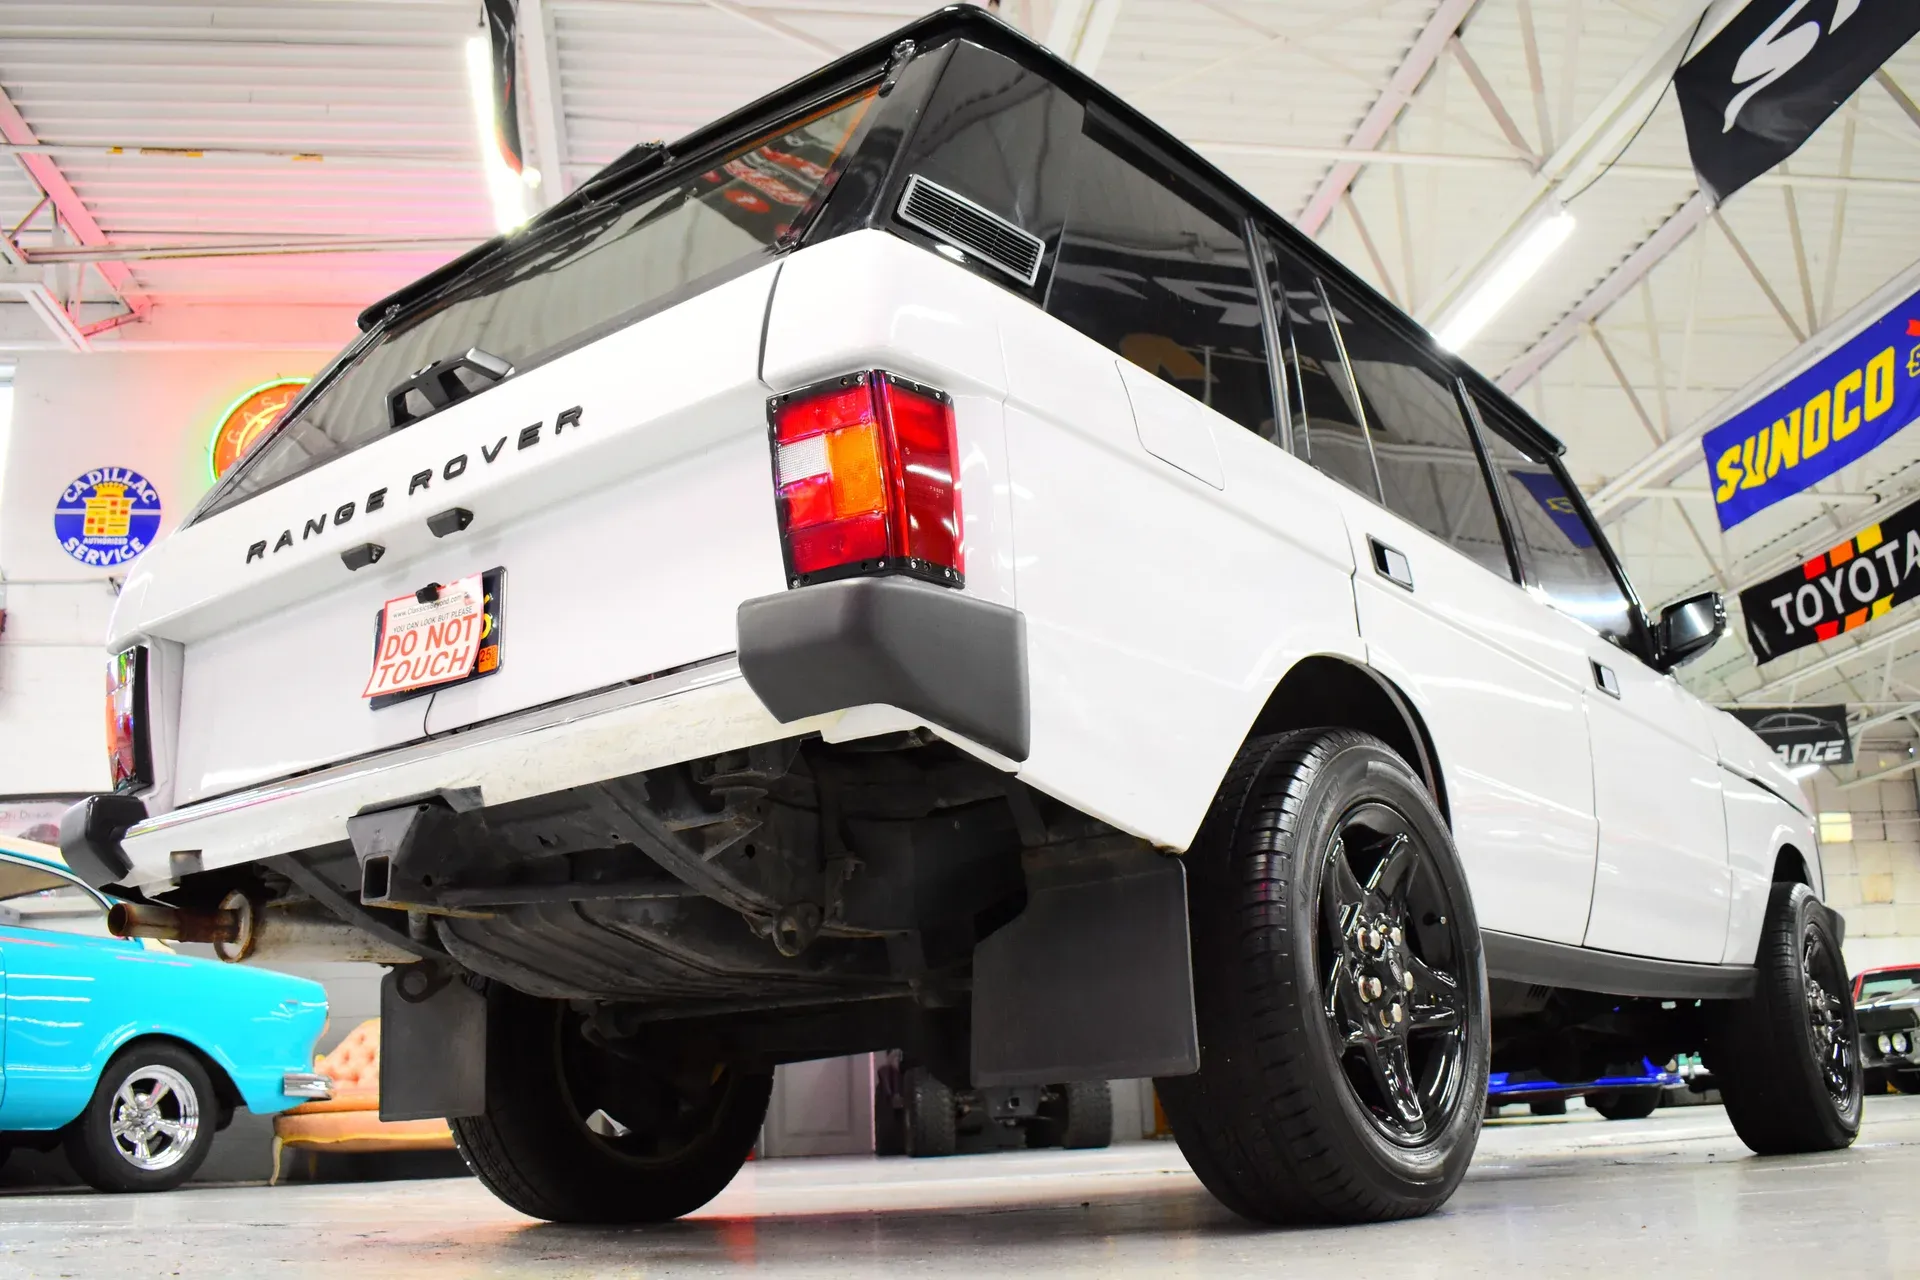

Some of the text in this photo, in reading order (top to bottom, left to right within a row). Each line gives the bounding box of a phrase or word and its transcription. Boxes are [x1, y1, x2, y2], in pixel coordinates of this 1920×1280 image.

[226, 391, 297, 444] GASO
[1716, 346, 1895, 504] SUNOCO
[63, 467, 158, 505] CADILLAC
[246, 405, 583, 565] RANGE ROVER
[63, 537, 146, 566] SERVICE
[1771, 529, 1920, 635] TOYOTA
[383, 629, 418, 661] DO
[425, 613, 478, 652] NOT
[393, 605, 473, 634] YOU CAN LOOK BUT PLEASE
[378, 645, 470, 688] TOUCH
[480, 648, 492, 663] 25
[1774, 740, 1845, 764] ANCE
